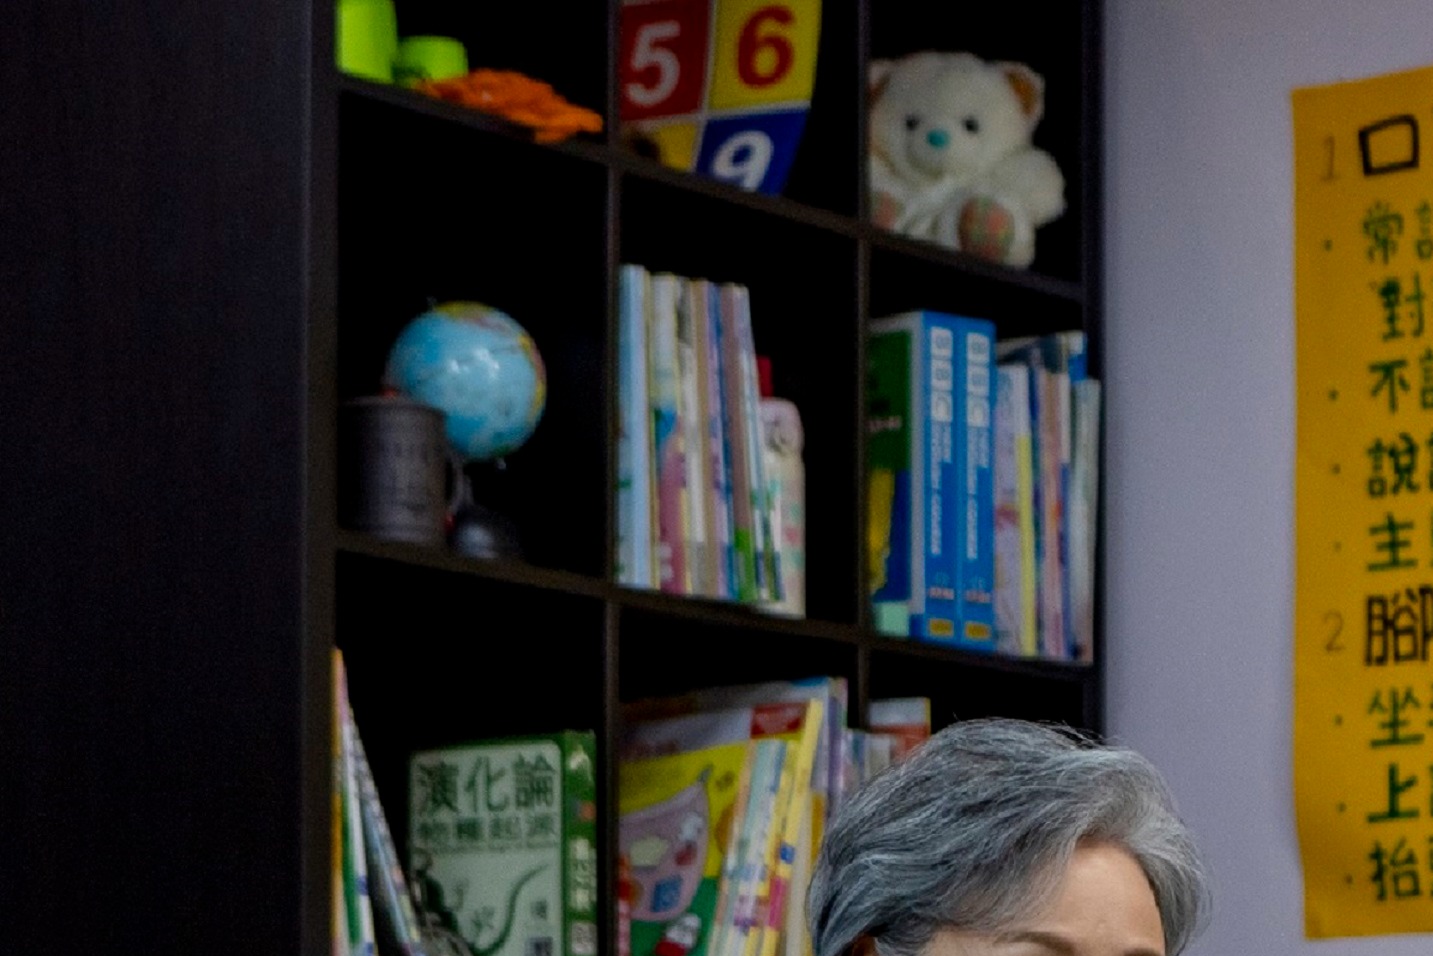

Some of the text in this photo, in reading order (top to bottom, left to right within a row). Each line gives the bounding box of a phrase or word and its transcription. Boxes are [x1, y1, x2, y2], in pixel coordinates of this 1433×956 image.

[624, 6, 795, 109] 5 6
[711, 128, 775, 193] 9
[1323, 608, 1346, 654] 2
